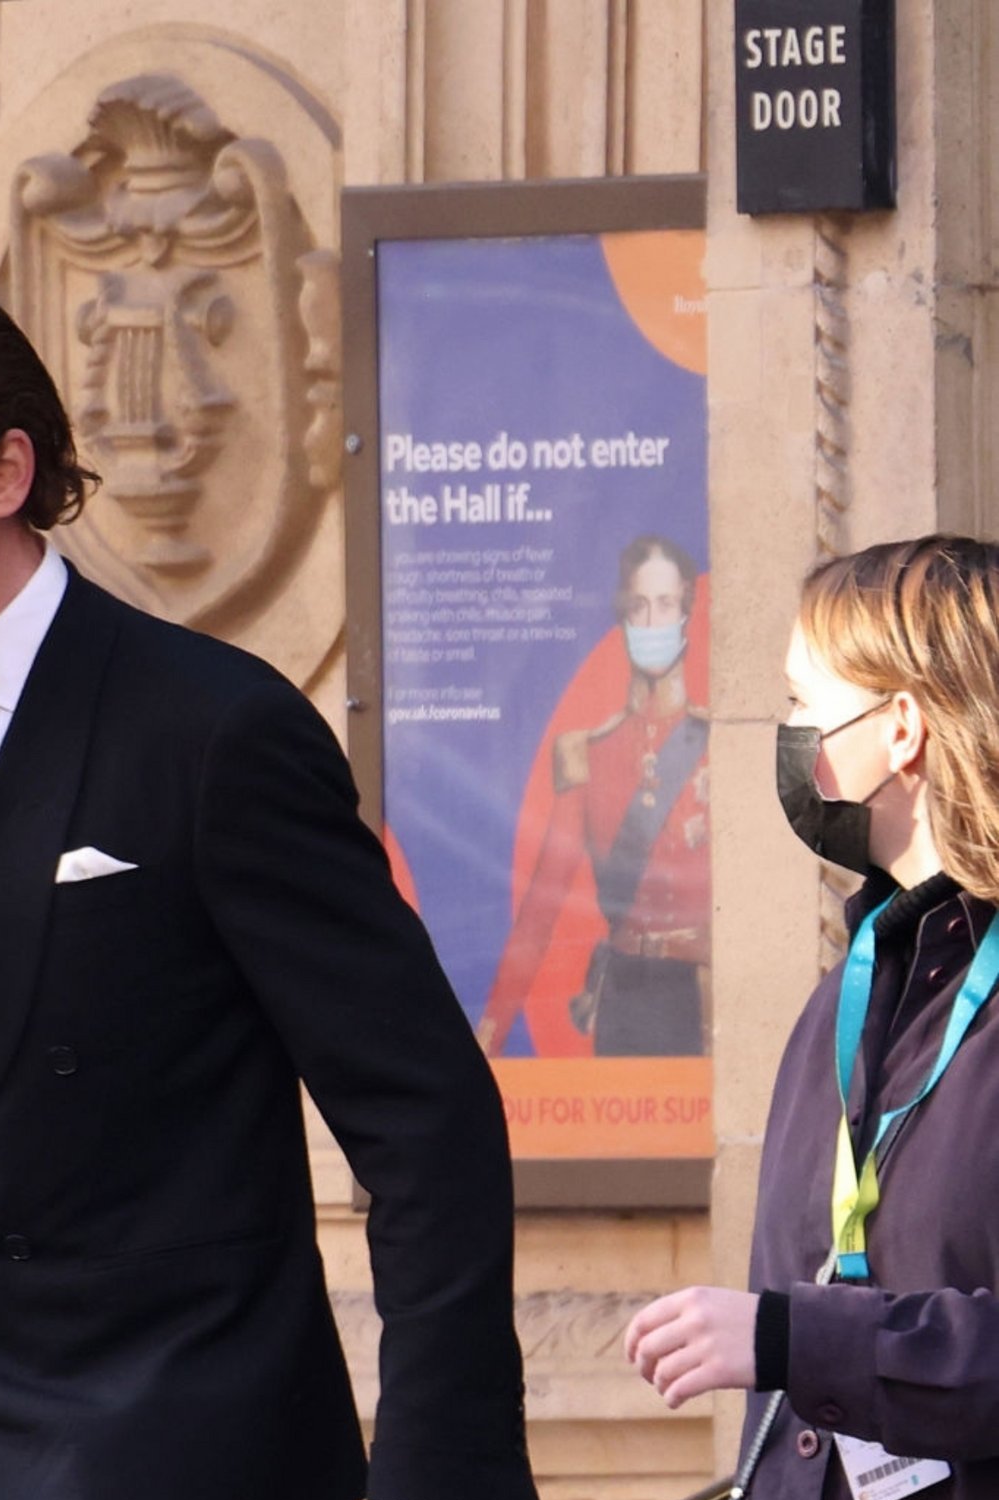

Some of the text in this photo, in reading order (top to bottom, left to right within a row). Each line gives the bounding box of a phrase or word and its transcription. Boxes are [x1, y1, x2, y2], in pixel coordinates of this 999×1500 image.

[745, 25, 846, 68] STAGE
[753, 89, 842, 131] DOOR
[386, 431, 670, 472] Please do not enter
[387, 483, 553, 524] the Hall if...
[388, 703, 501, 726] gov.uk/coronavirus
[539, 1096, 584, 1123] FOR
[591, 1096, 659, 1123] YOUR
[663, 1096, 711, 1123] SUP
